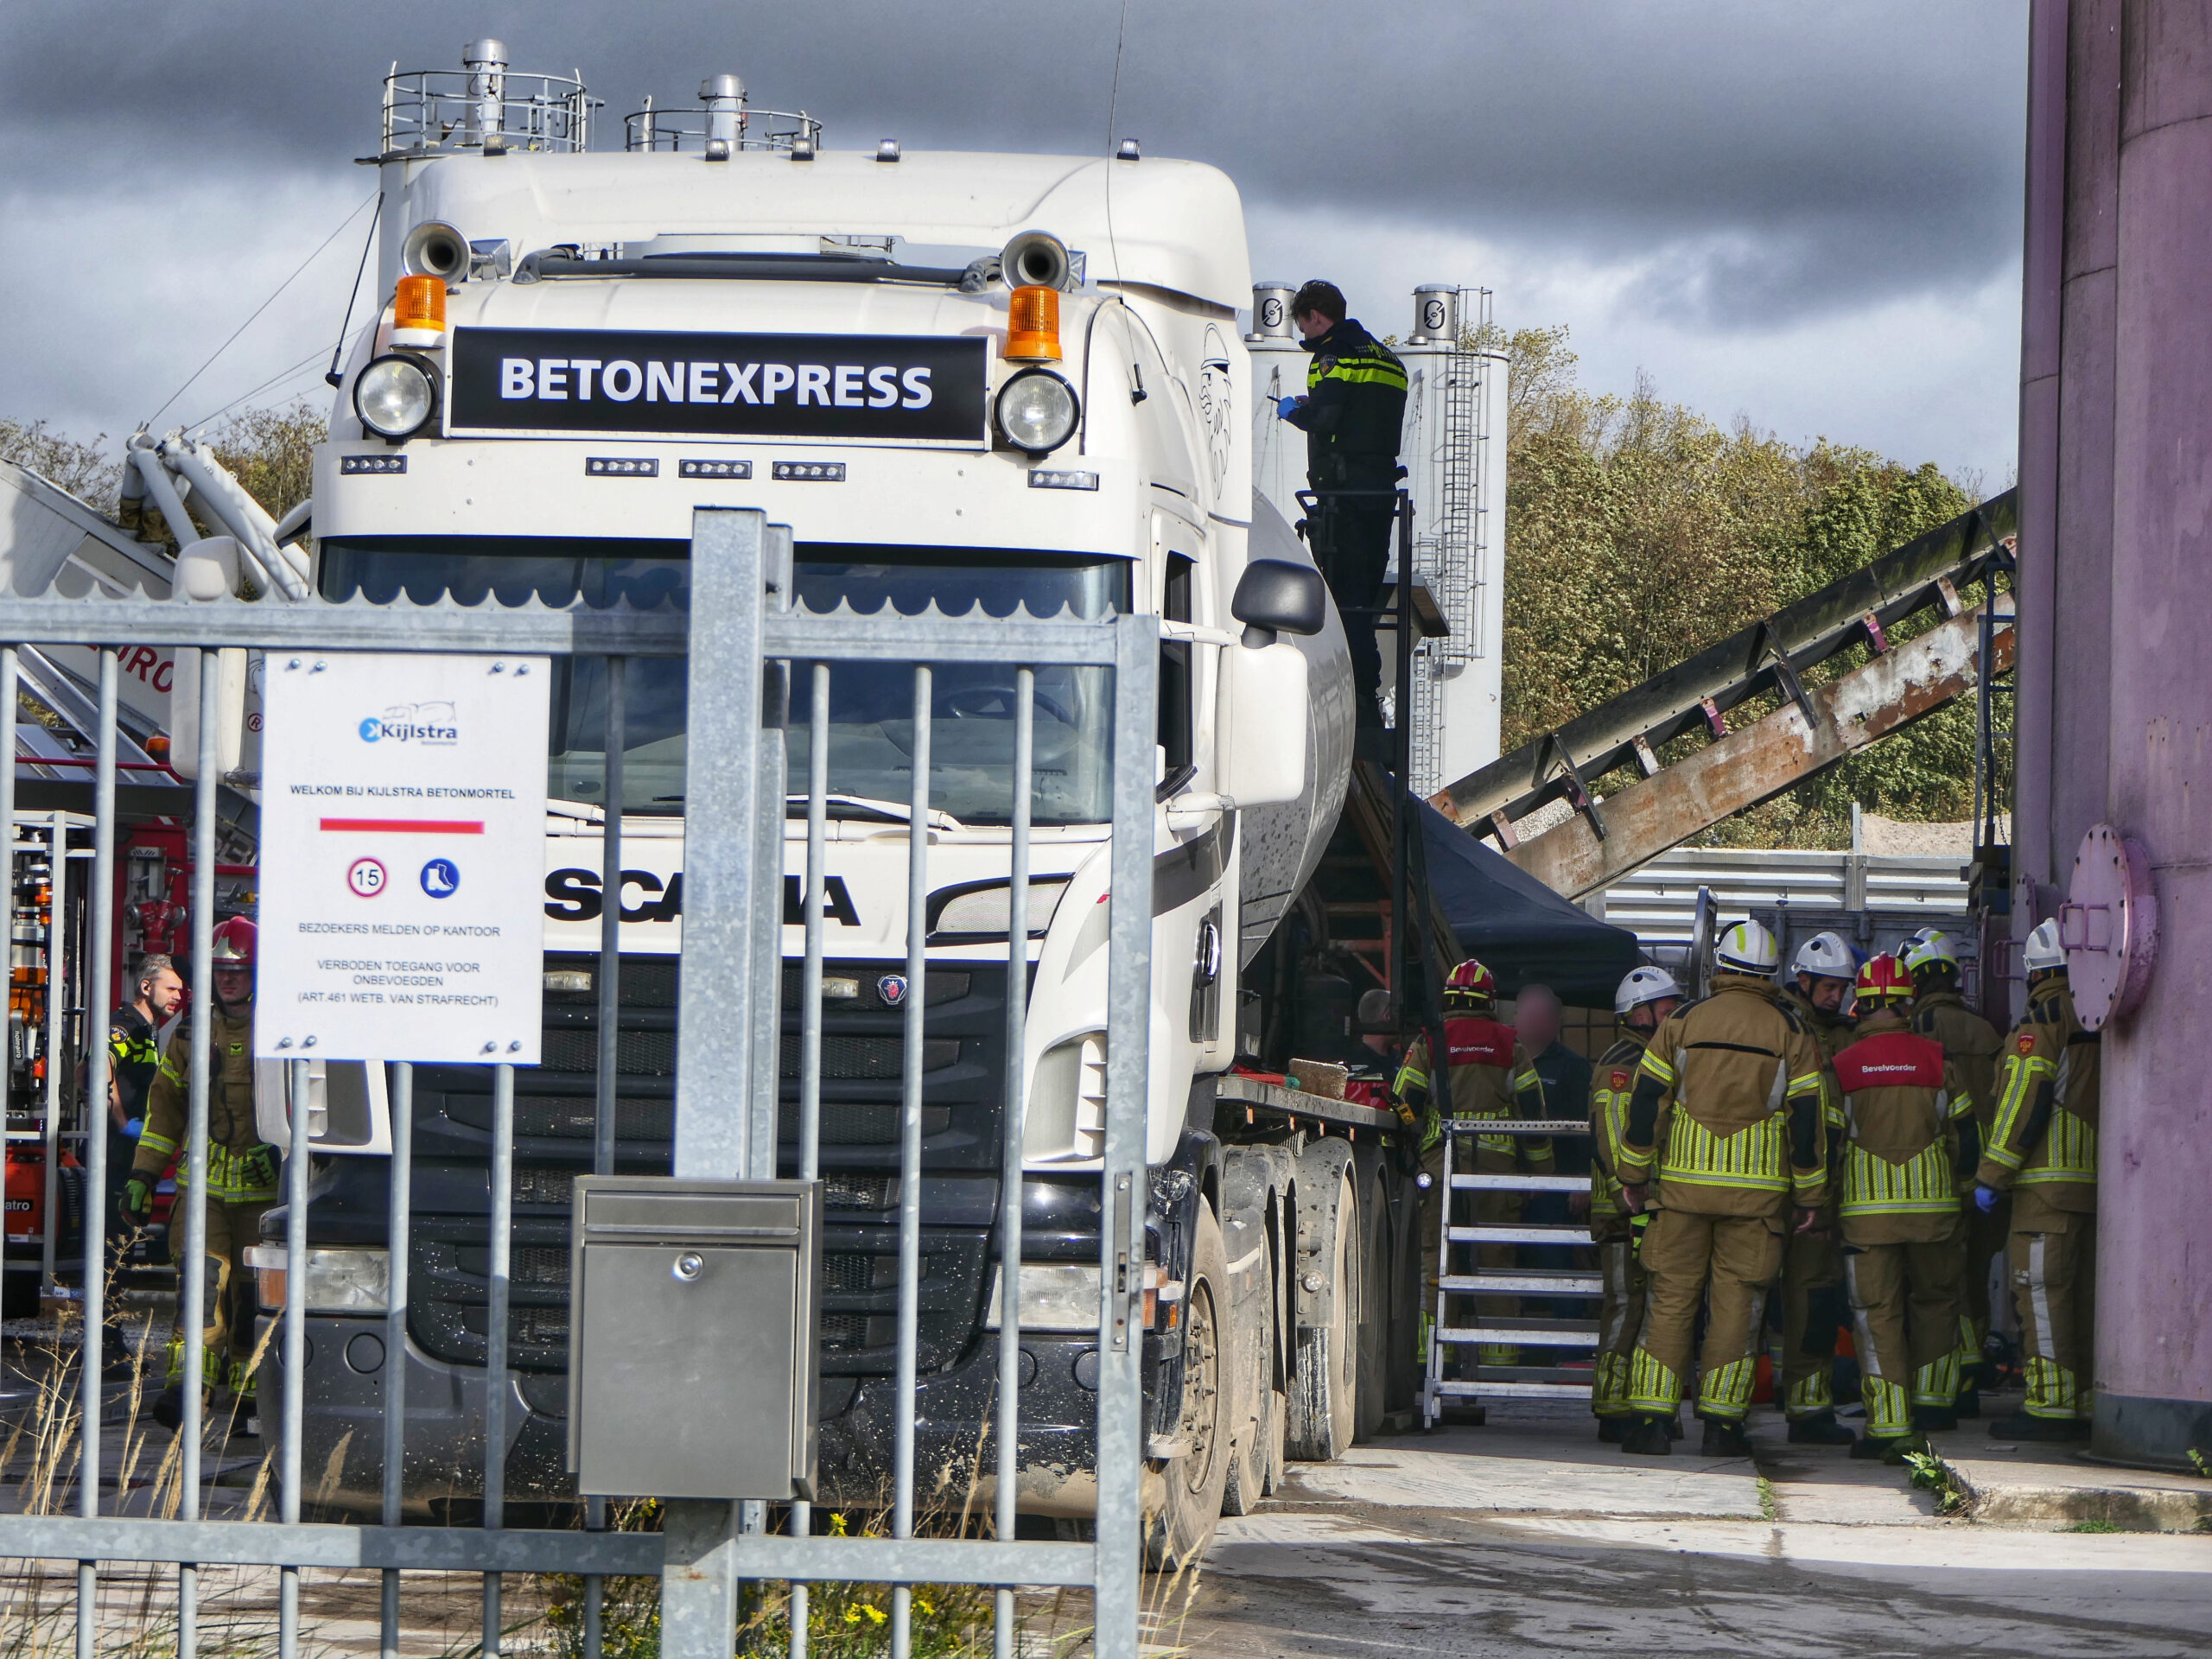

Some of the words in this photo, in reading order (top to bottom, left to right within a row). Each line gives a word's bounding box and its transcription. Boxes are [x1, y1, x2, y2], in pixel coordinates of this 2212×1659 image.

[501, 358, 933, 410] BETONEXPRESS
[381, 724, 458, 741] Kijlstra
[290, 785, 342, 796] WELKOM
[346, 786, 364, 797] BIJ
[367, 786, 423, 798] KIJLSTRA
[427, 788, 516, 799] BETONMORTEL
[356, 869, 379, 886] 15
[544, 868, 861, 927] SCIA
[298, 923, 370, 934] BEZOEKERS
[372, 925, 421, 936] MELDEN
[423, 925, 441, 936] OP
[443, 926, 501, 937] KANTOOR
[317, 960, 383, 971] VERBODEN
[385, 961, 443, 972] TOEGANG
[446, 962, 480, 973] VOOR
[353, 976, 444, 987] ONBEVOEGDEN
[298, 992, 347, 1004] (ART.461
[350, 993, 386, 1004] WETB.
[391, 994, 414, 1005] VAN
[416, 995, 499, 1007] STRAFRECHT)
[1861, 1064, 1916, 1073] Bevelvoerder
[5, 1200, 30, 1211] atro
